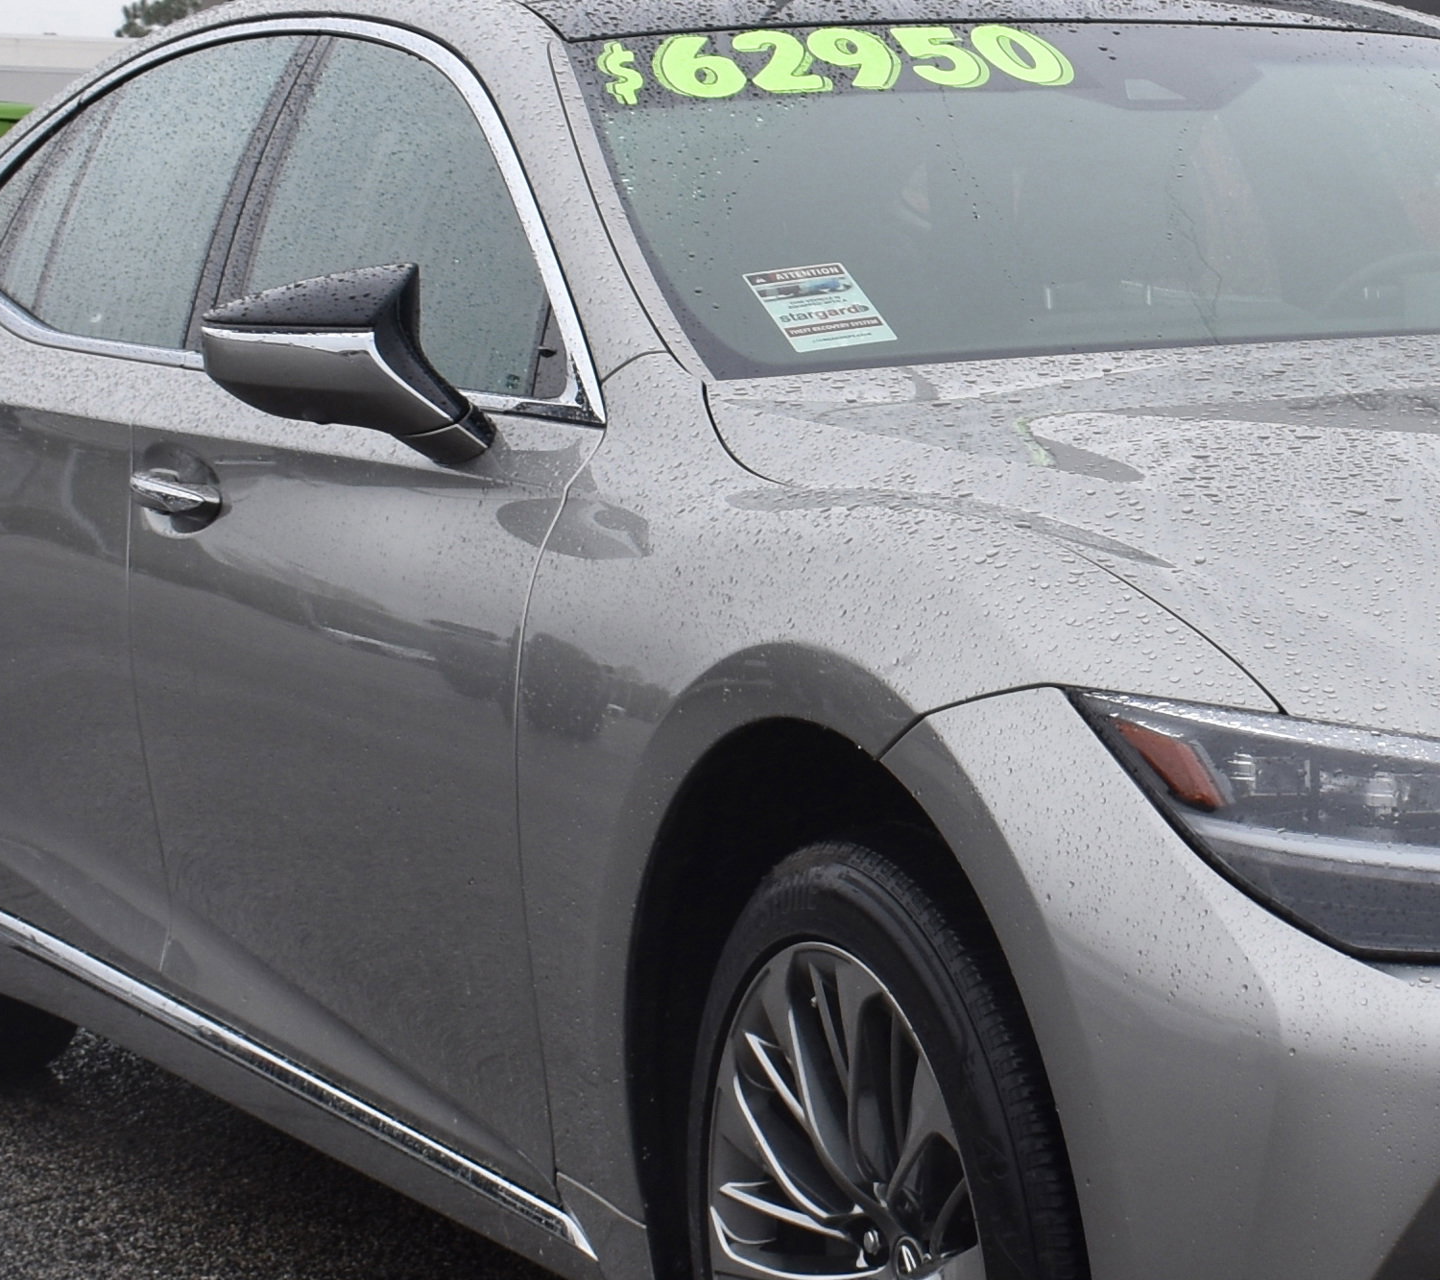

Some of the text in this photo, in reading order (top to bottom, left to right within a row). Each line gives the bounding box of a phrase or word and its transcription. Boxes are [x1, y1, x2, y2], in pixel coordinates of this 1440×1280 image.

[596, 23, 1075, 106] $62950
[776, 266, 839, 280] ATTENTION
[779, 303, 861, 324] stargard
